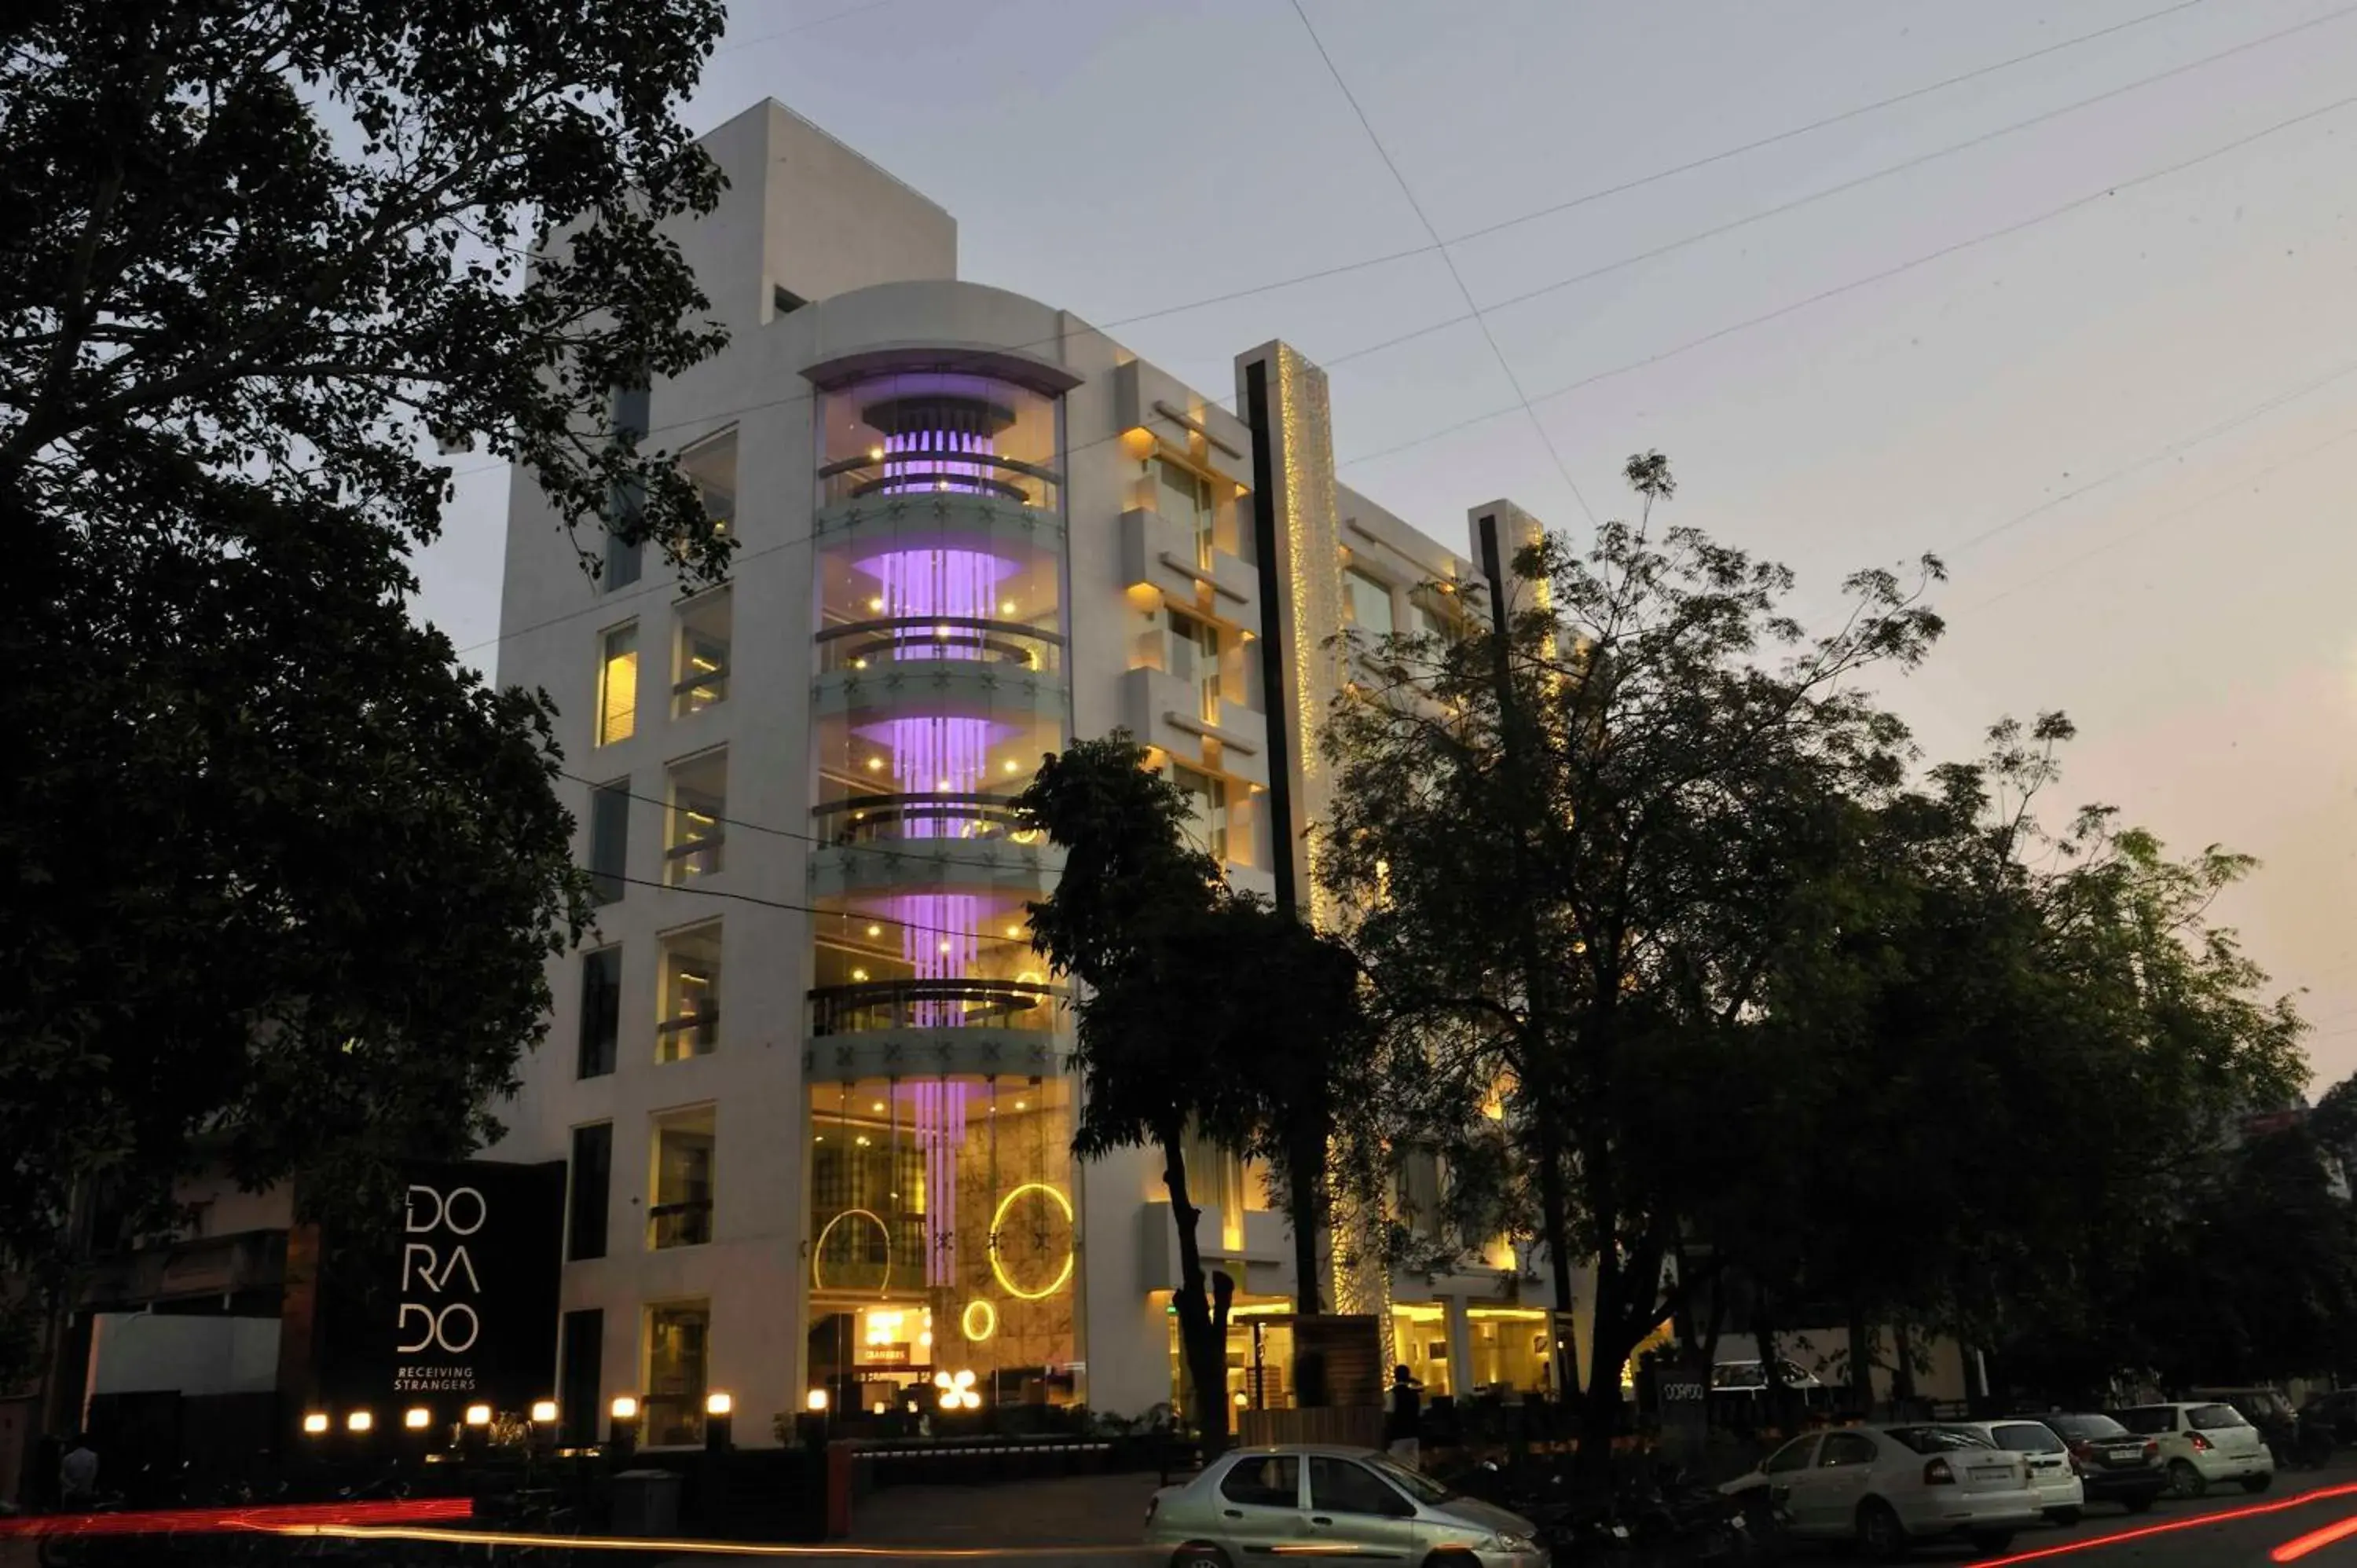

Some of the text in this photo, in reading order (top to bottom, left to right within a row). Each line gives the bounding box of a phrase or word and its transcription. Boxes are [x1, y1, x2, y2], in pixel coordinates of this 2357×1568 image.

[405, 1185, 486, 1235] DO
[402, 1244, 481, 1292] RA
[397, 1303, 478, 1353] DO
[394, 1379, 476, 1390] STRANGERS
[398, 1367, 473, 1378] RECEIVING
